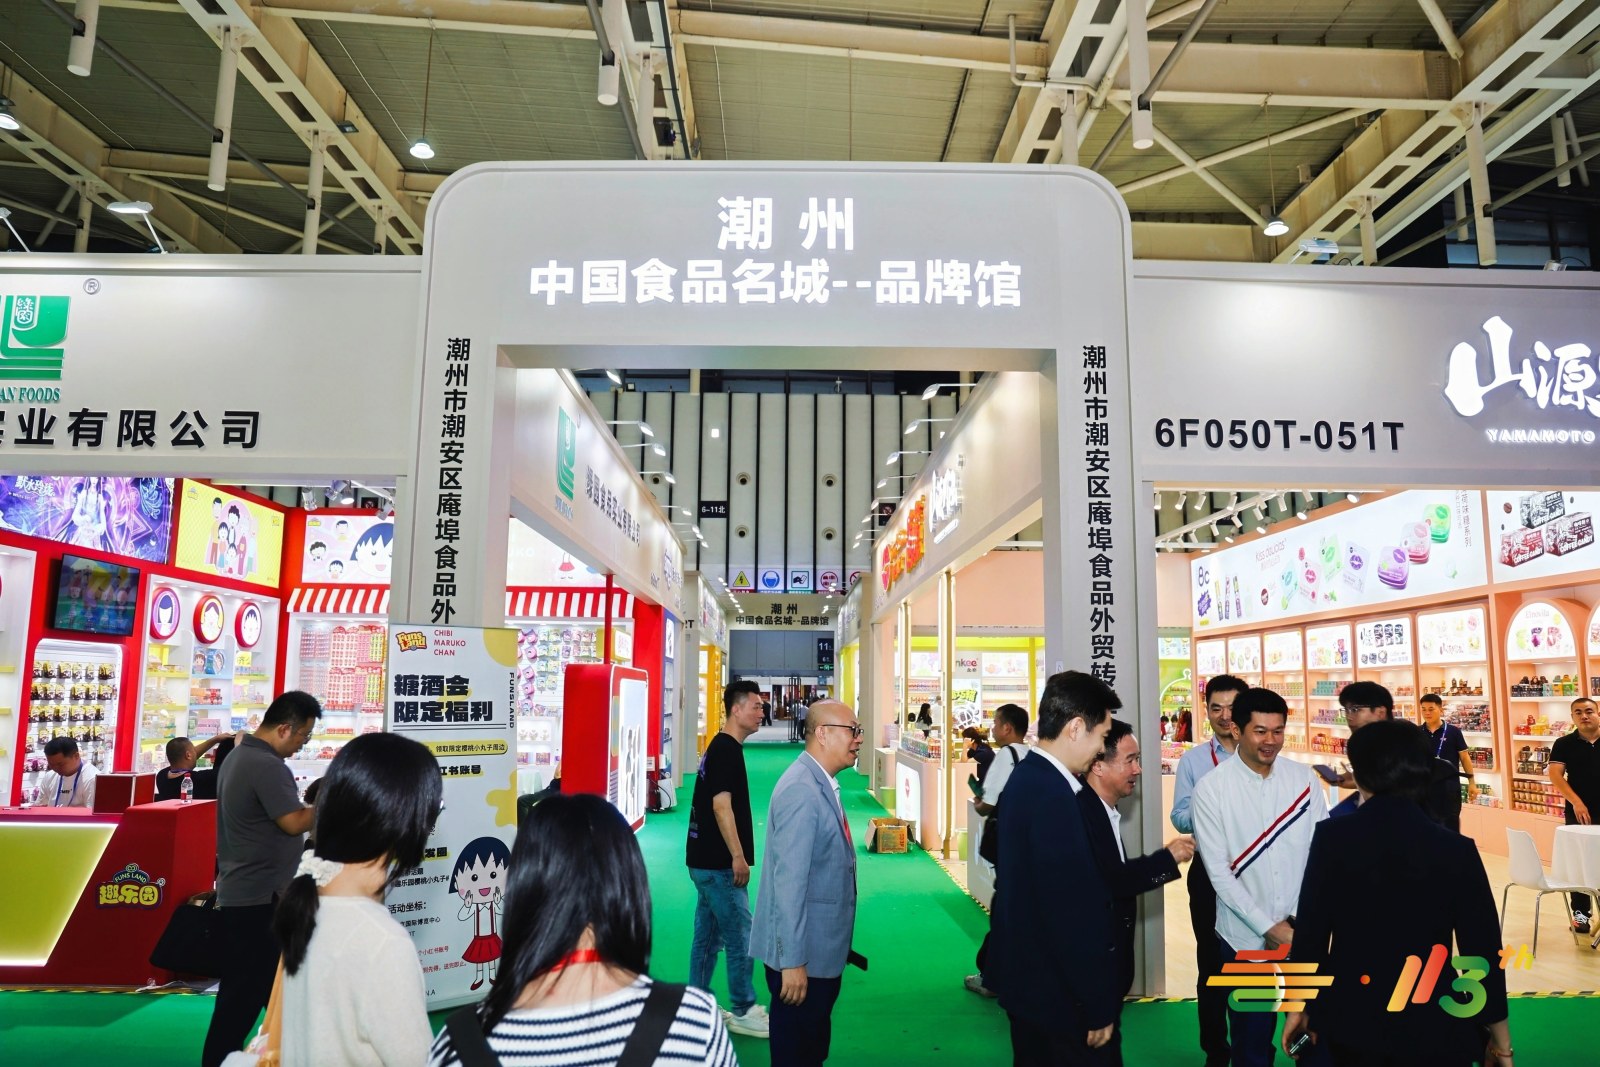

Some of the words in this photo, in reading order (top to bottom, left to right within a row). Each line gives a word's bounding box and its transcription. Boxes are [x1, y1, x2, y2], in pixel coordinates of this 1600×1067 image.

[717, 196, 854, 251] 潮州
[529, 257, 1022, 308] 中国食品名城--品牌馆
[1444, 315, 1600, 418] 山源
[18, 387, 61, 402] FOODS
[0, 407, 260, 449] 业有限公司
[1155, 417, 1404, 451] 6F050T-051T
[1486, 428, 1596, 444] YAMAMOTO
[431, 338, 471, 625] 潮州市潮安区庵埠食品外
[771, 603, 798, 615] 潮州
[434, 629, 453, 637] CHIBI
[434, 639, 466, 647] MARUKO
[394, 674, 469, 697] 糖酒会
[394, 701, 493, 723] 限定福利
[99, 884, 159, 906] 趣乐园
